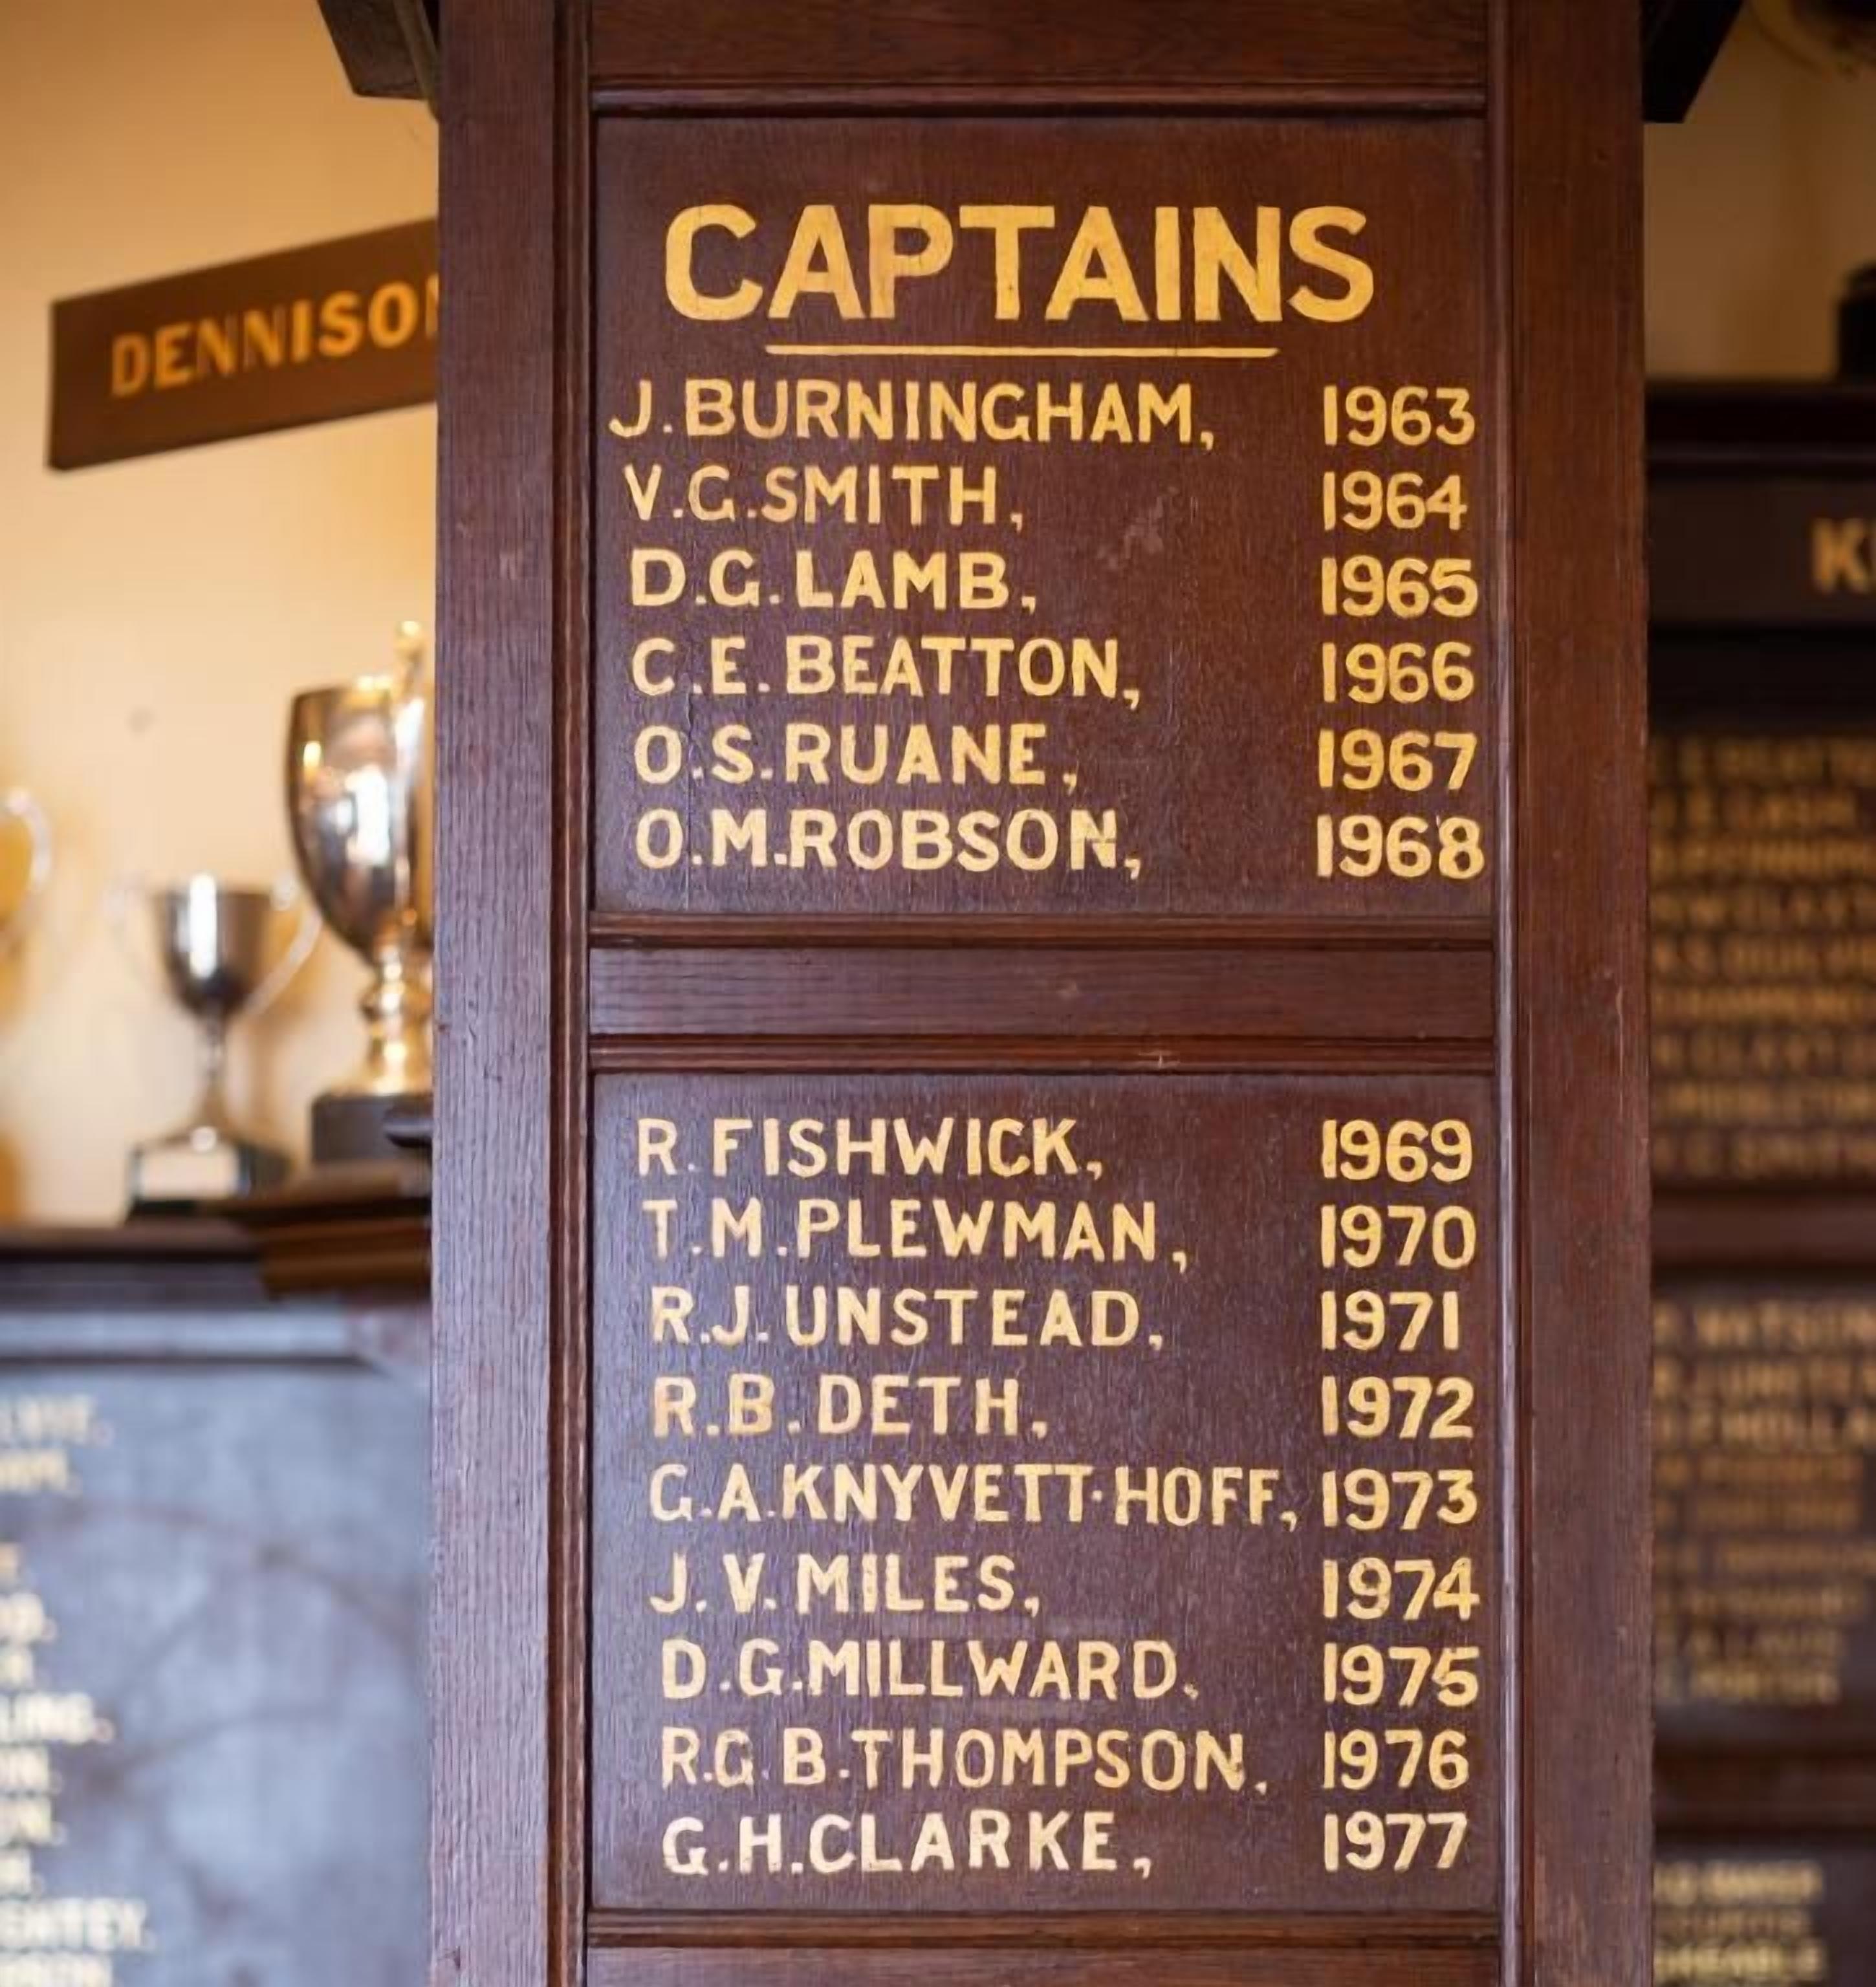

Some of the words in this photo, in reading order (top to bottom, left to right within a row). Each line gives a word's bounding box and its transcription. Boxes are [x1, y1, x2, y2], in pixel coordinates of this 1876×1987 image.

[665, 204, 1374, 322] CAPTAINS
[111, 270, 439, 398] DENNISO
[1324, 385, 1476, 446] 1963
[1323, 470, 1468, 531] 1964
[1322, 555, 1479, 618] 1965
[1322, 641, 1474, 704] 1966
[1318, 729, 1478, 791] 1967
[1317, 814, 1485, 879] 1968
[1321, 1119, 1473, 1182] 1969
[1321, 1204, 1476, 1269] 1970
[1321, 1290, 1459, 1351] 1971
[1322, 1376, 1474, 1439] 1972
[1322, 1468, 1478, 1530] 1973
[1323, 1557, 1480, 1620] 1974
[1324, 1643, 1480, 1707] 1975
[1323, 1729, 1468, 1790] 1976
[1324, 1810, 1468, 1872] 1977
